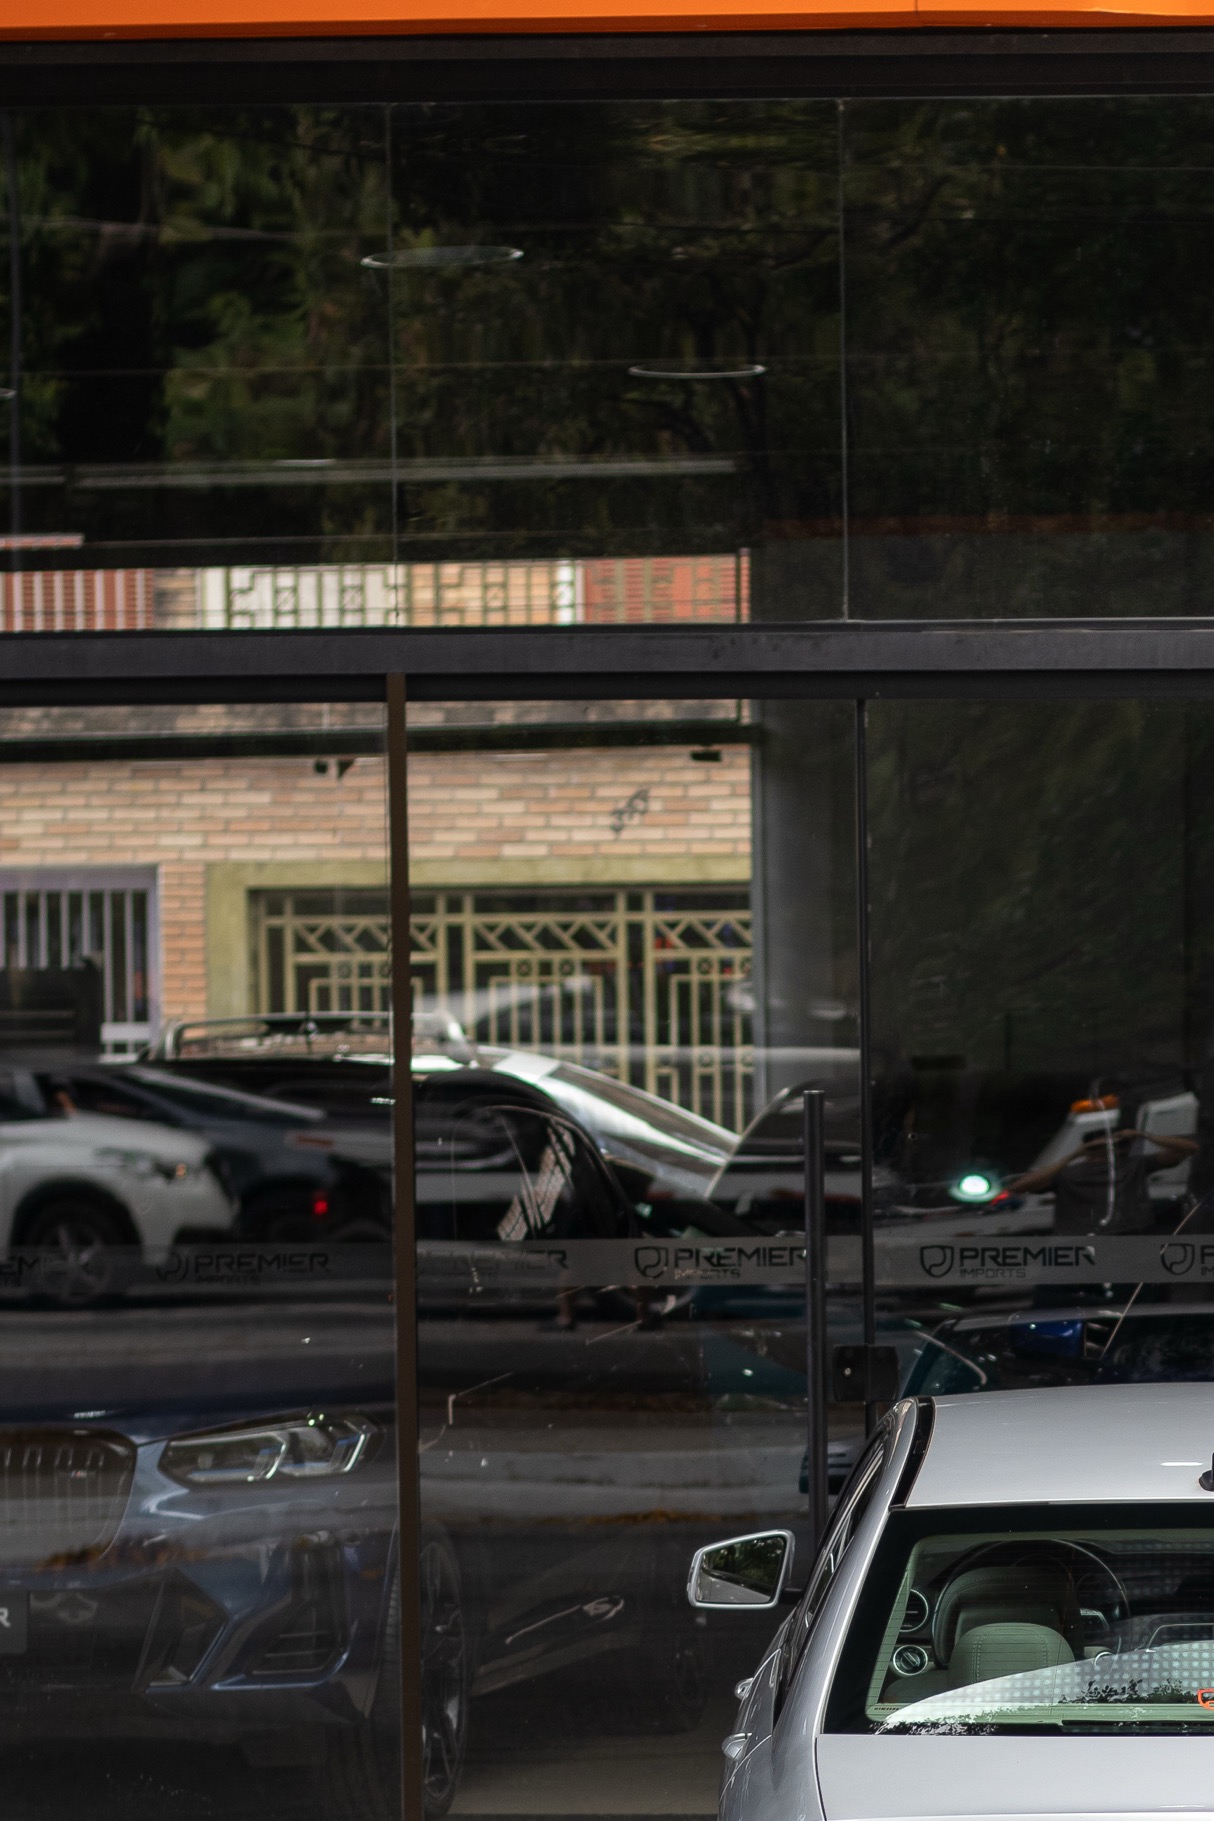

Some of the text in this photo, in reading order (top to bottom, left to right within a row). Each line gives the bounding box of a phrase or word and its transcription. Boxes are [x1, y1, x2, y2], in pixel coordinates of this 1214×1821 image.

[194, 1252, 331, 1273] PREMIER
[674, 1247, 807, 1268] PREMIER
[959, 1246, 1096, 1267] PREMIER
[959, 1268, 1026, 1279] IMPORTS
